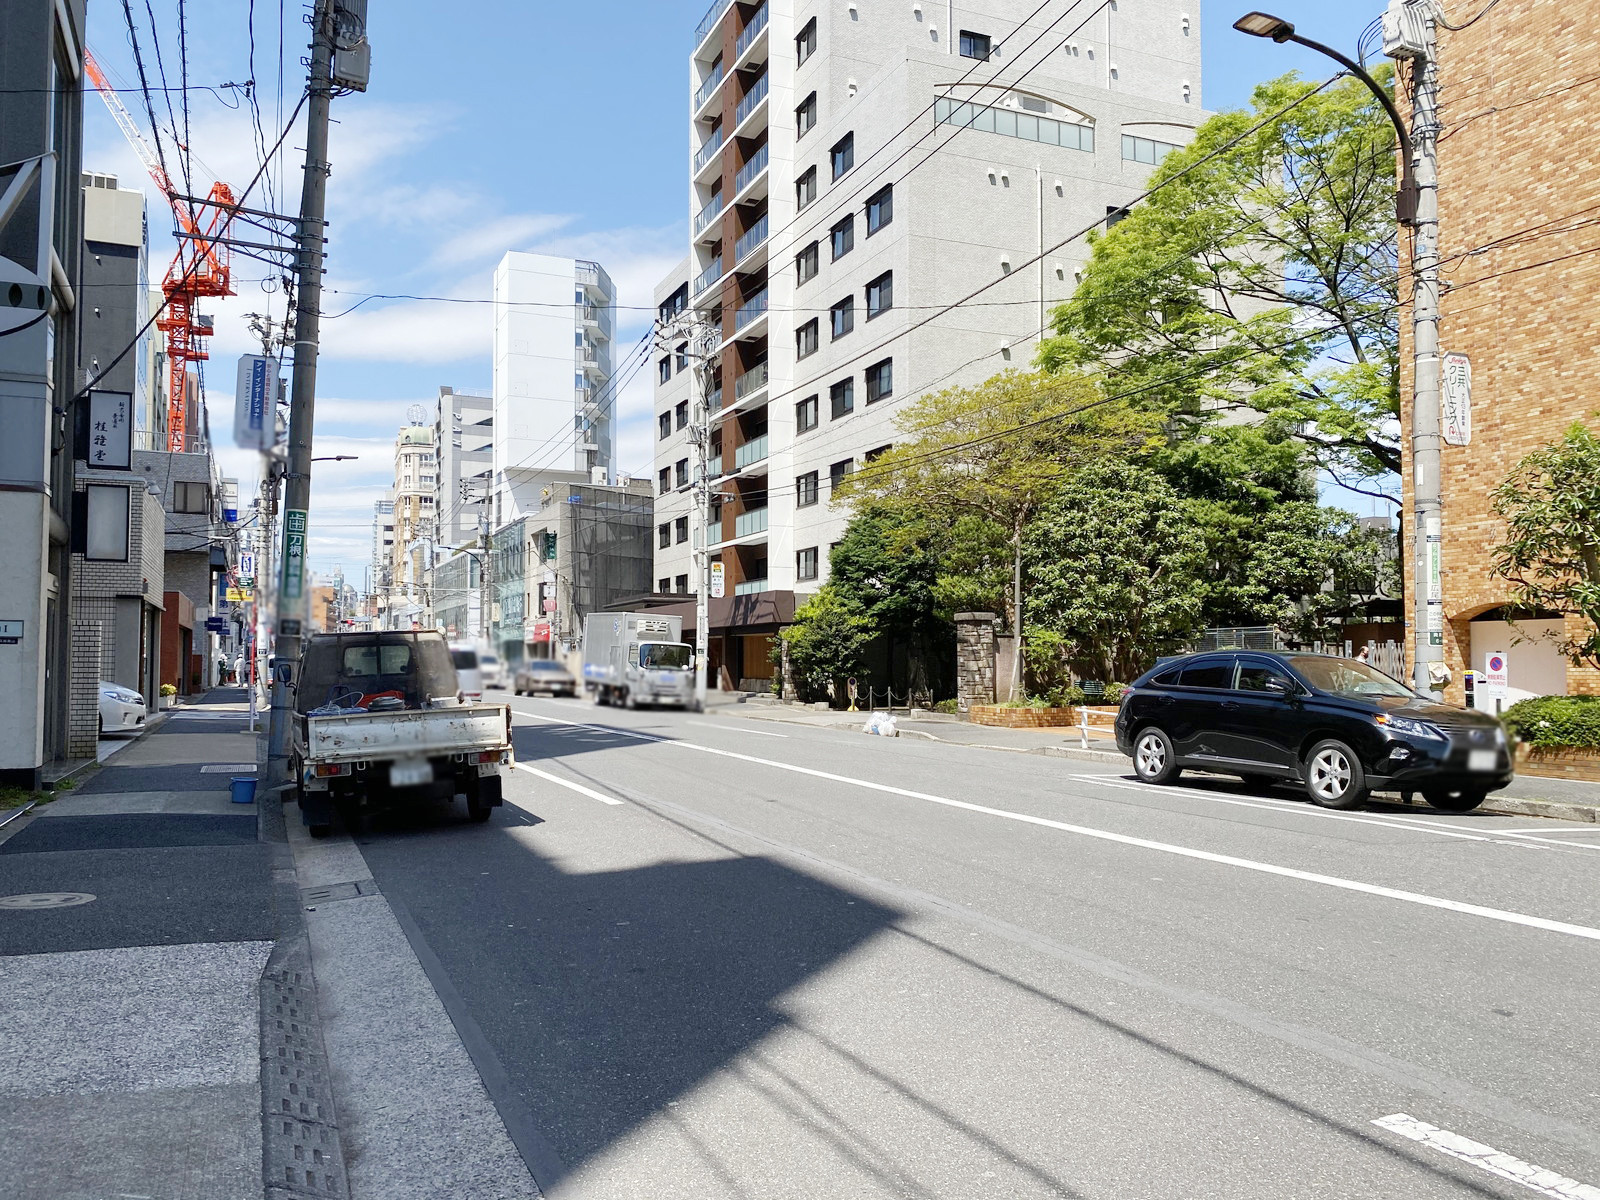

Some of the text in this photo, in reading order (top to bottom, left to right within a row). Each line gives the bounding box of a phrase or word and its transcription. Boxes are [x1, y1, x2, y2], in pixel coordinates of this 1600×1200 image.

[252, 361, 263, 428] アイ・インターナショナ
[1449, 365, 1457, 425] クリーニング
[1458, 366, 1466, 388] 三共
[288, 513, 306, 532] 歯
